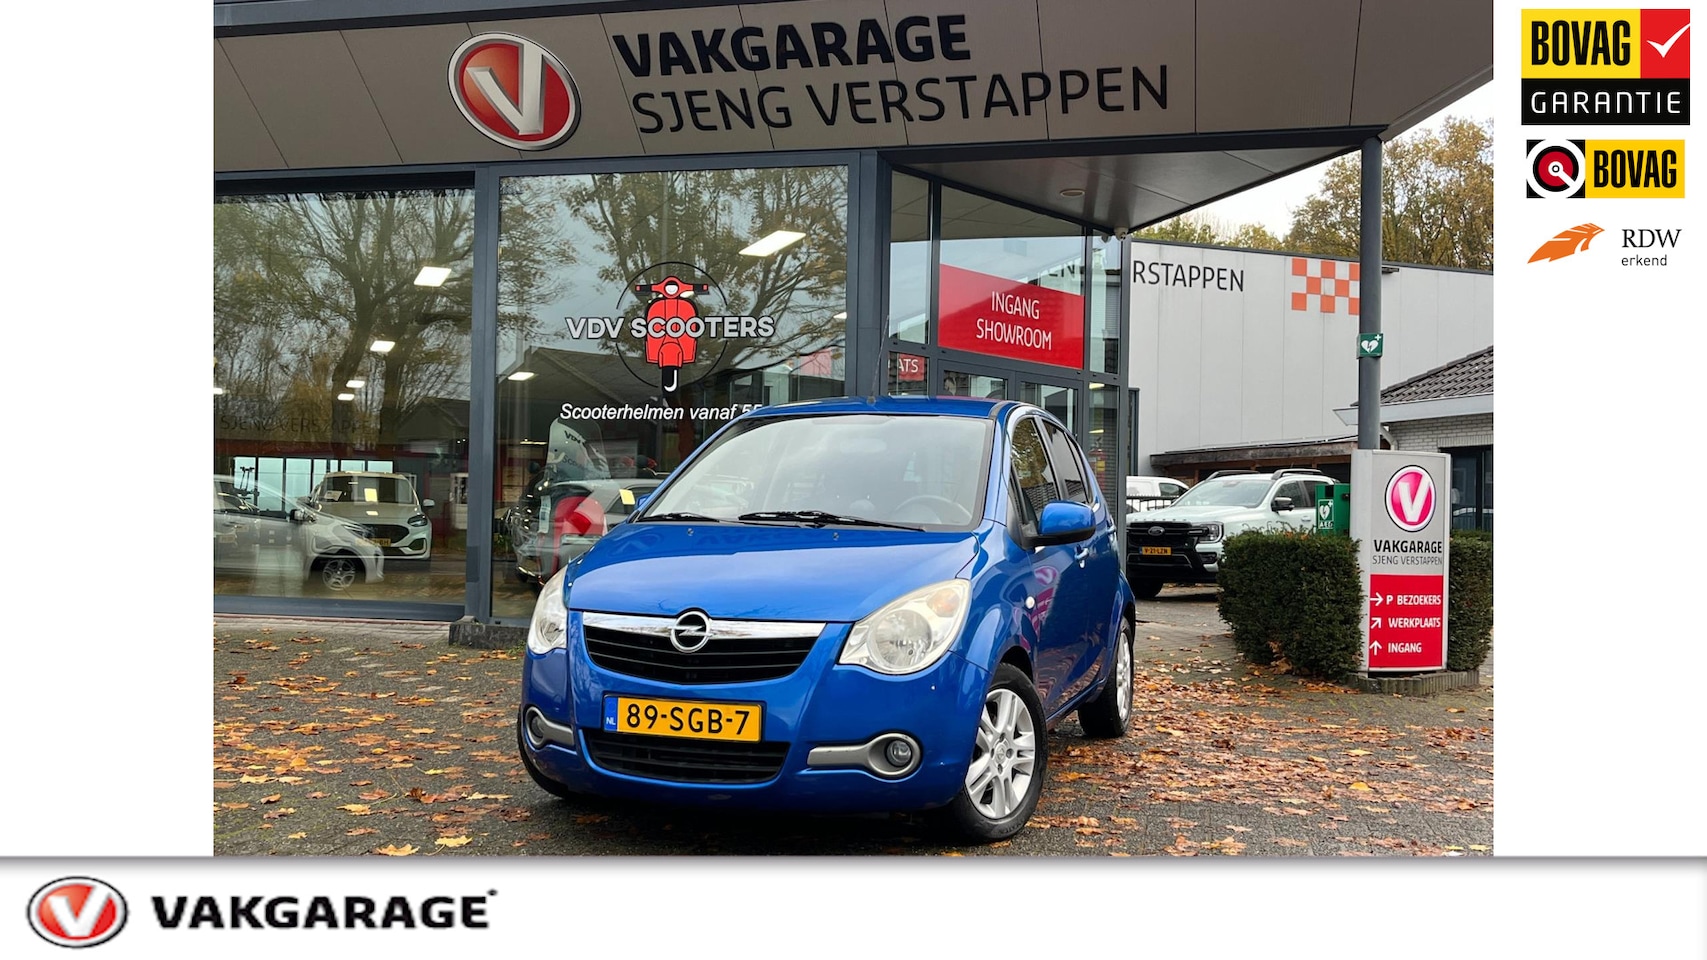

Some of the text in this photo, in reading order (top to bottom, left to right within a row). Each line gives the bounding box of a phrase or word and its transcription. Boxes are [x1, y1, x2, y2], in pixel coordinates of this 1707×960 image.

[613, 14, 971, 77] VAKGARAGE
[632, 65, 1167, 134] SJENG VERSTAPPEN
[1133, 260, 1244, 292] RSTAPPEN
[991, 291, 1040, 320] INGANG
[565, 316, 775, 339] VDV SCOOTERS
[976, 318, 1052, 351] SHOWROOM
[560, 402, 684, 420] Scooterhelmen
[689, 403, 738, 420] vanaf
[1374, 539, 1442, 553] VAKGARAGE
[1372, 555, 1442, 566] SJENG VERSTAPPEN
[1386, 594, 1441, 606] P BEZOEKERS
[1388, 617, 1441, 628] WERKPLAATS
[1388, 642, 1422, 653] INGANG
[606, 703, 750, 735] NL 89-SGB-7
